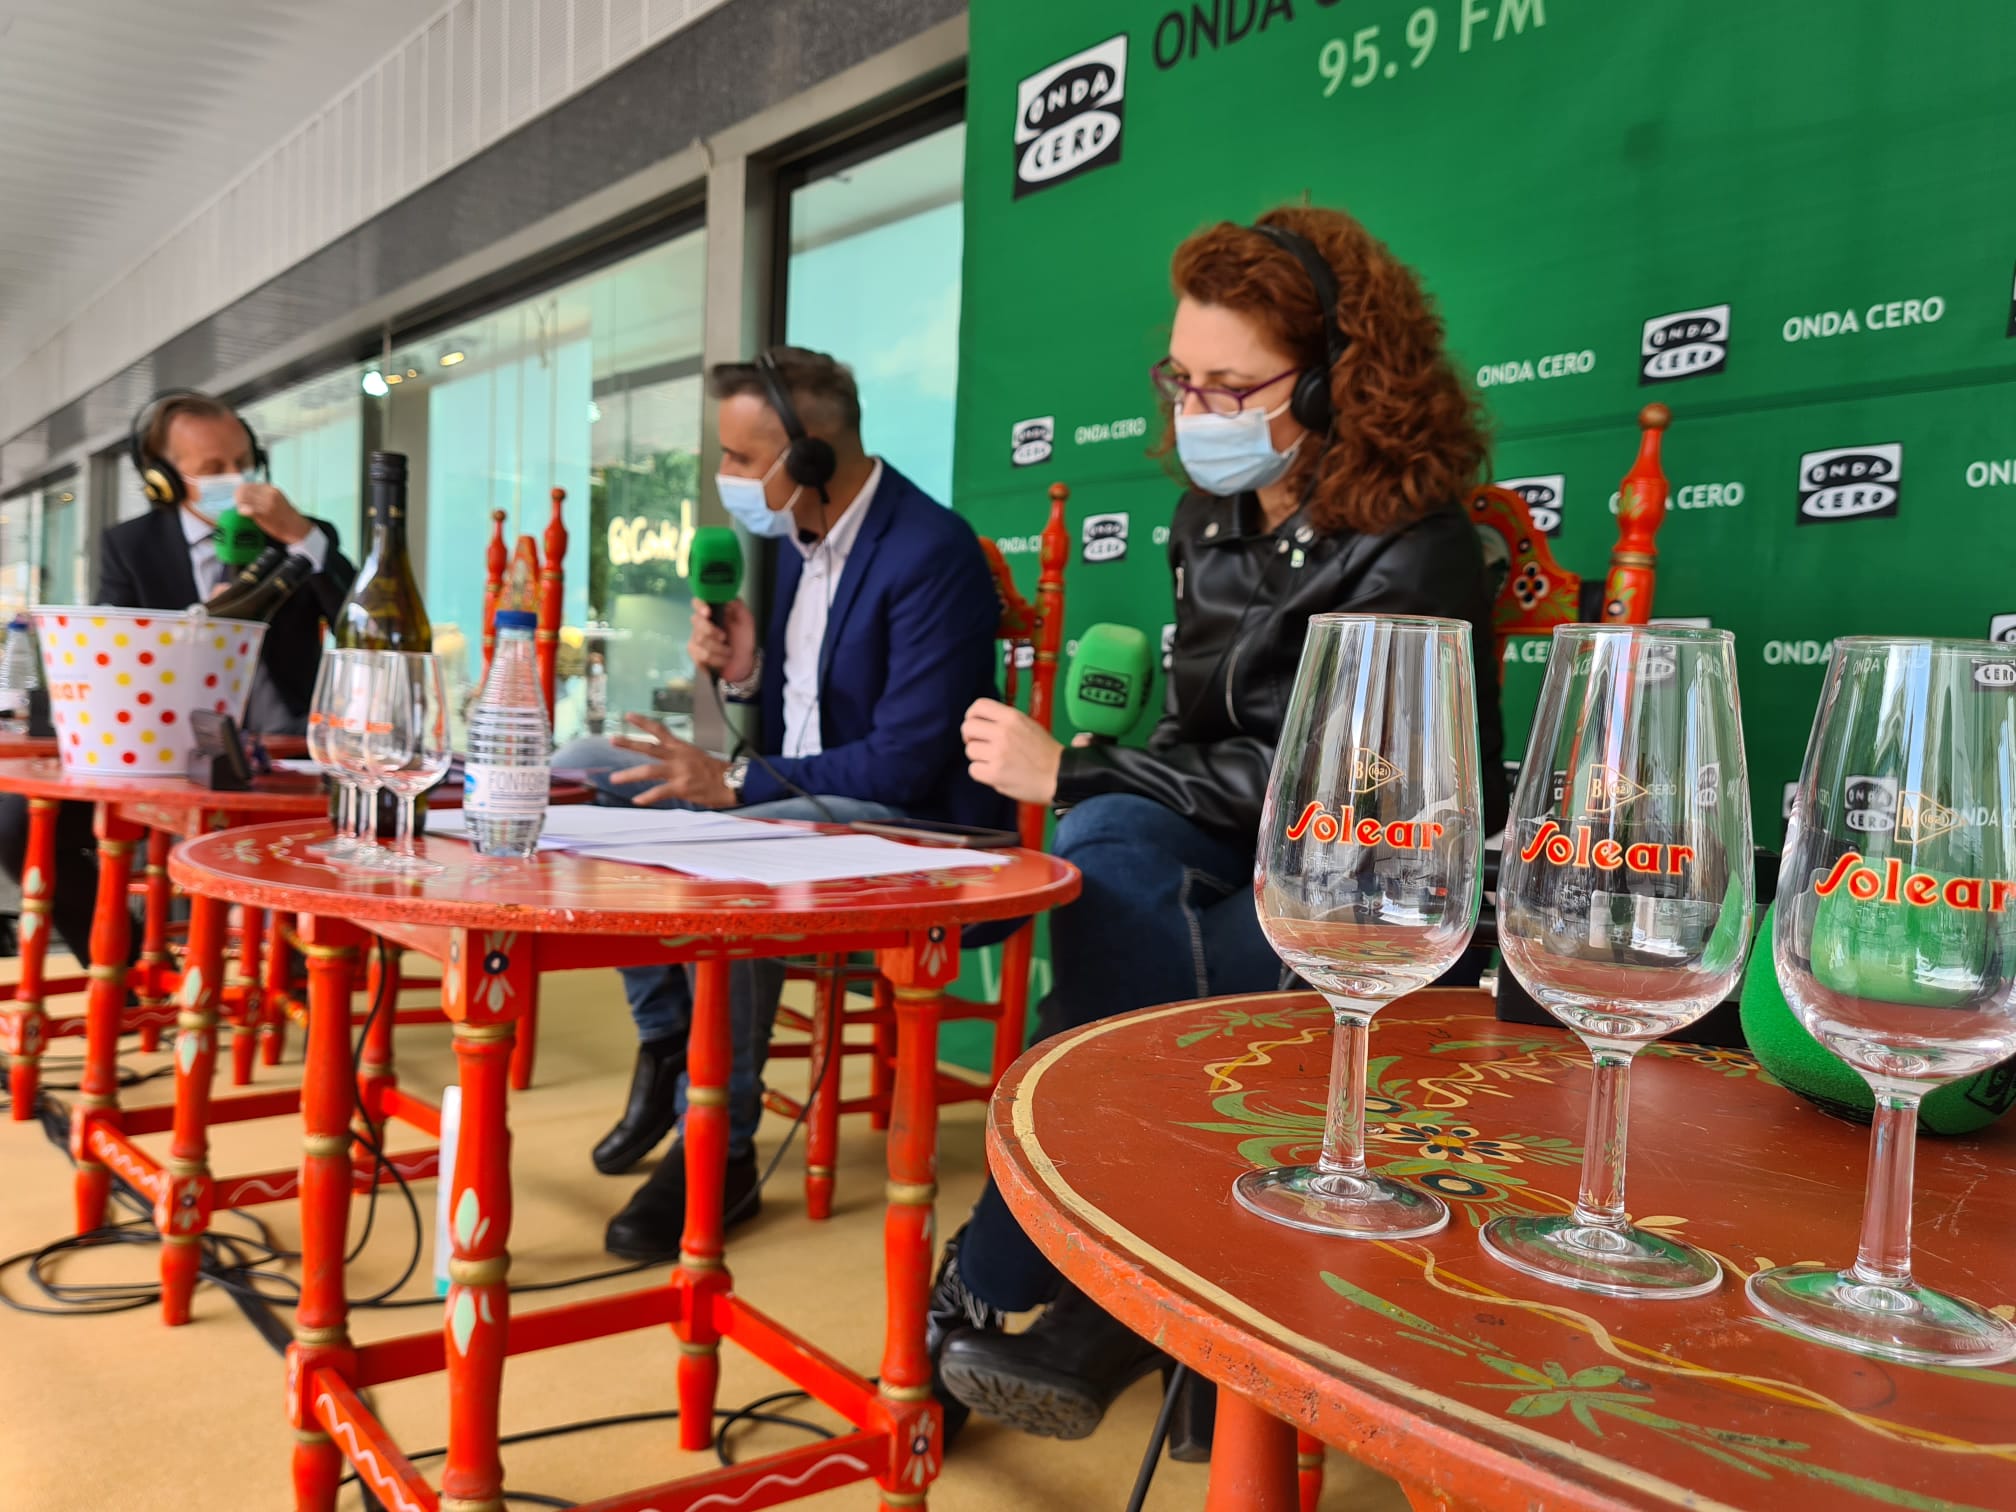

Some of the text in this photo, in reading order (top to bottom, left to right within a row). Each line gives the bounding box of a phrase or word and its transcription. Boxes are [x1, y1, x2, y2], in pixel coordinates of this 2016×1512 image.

[1318, 7, 1438, 98] 95.9
[1028, 69, 1109, 124] ONDA
[1034, 122, 1105, 169] CERO
[1652, 320, 1716, 346] ONDA
[1782, 296, 1946, 343] ONDA CERO
[1476, 349, 1596, 388] ONDA CERO
[1655, 350, 1713, 371] CERO
[1811, 460, 1886, 482] ONDA
[1965, 459, 2016, 489] ON
[1677, 482, 1745, 510] CERO
[1815, 490, 1883, 510] CERO
[1354, 761, 1364, 780] B
[1592, 778, 1602, 798] B
[1286, 800, 1444, 850] Solear
[1520, 821, 1694, 875] Solear
[1814, 851, 2016, 912] Solear
